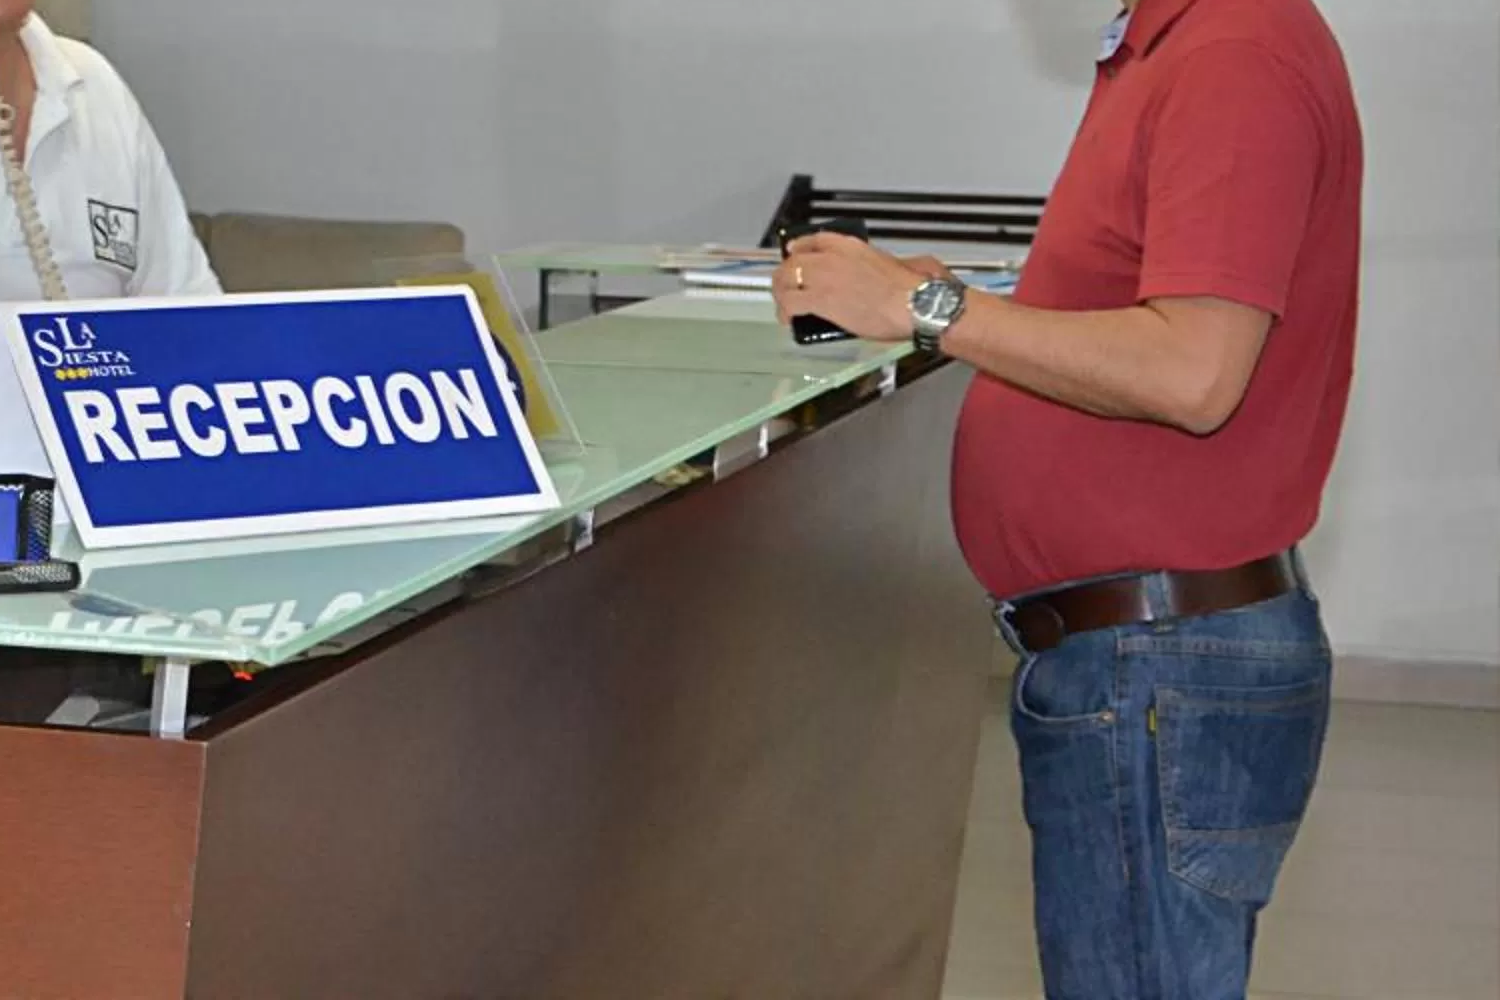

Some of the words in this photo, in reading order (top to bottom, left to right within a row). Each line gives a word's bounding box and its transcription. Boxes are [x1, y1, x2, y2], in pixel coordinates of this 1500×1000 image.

[33, 329, 130, 367] SIESTA
[54, 317, 96, 350] LA
[88, 365, 136, 377] HOTEL
[66, 368, 498, 463] RECEPCION
